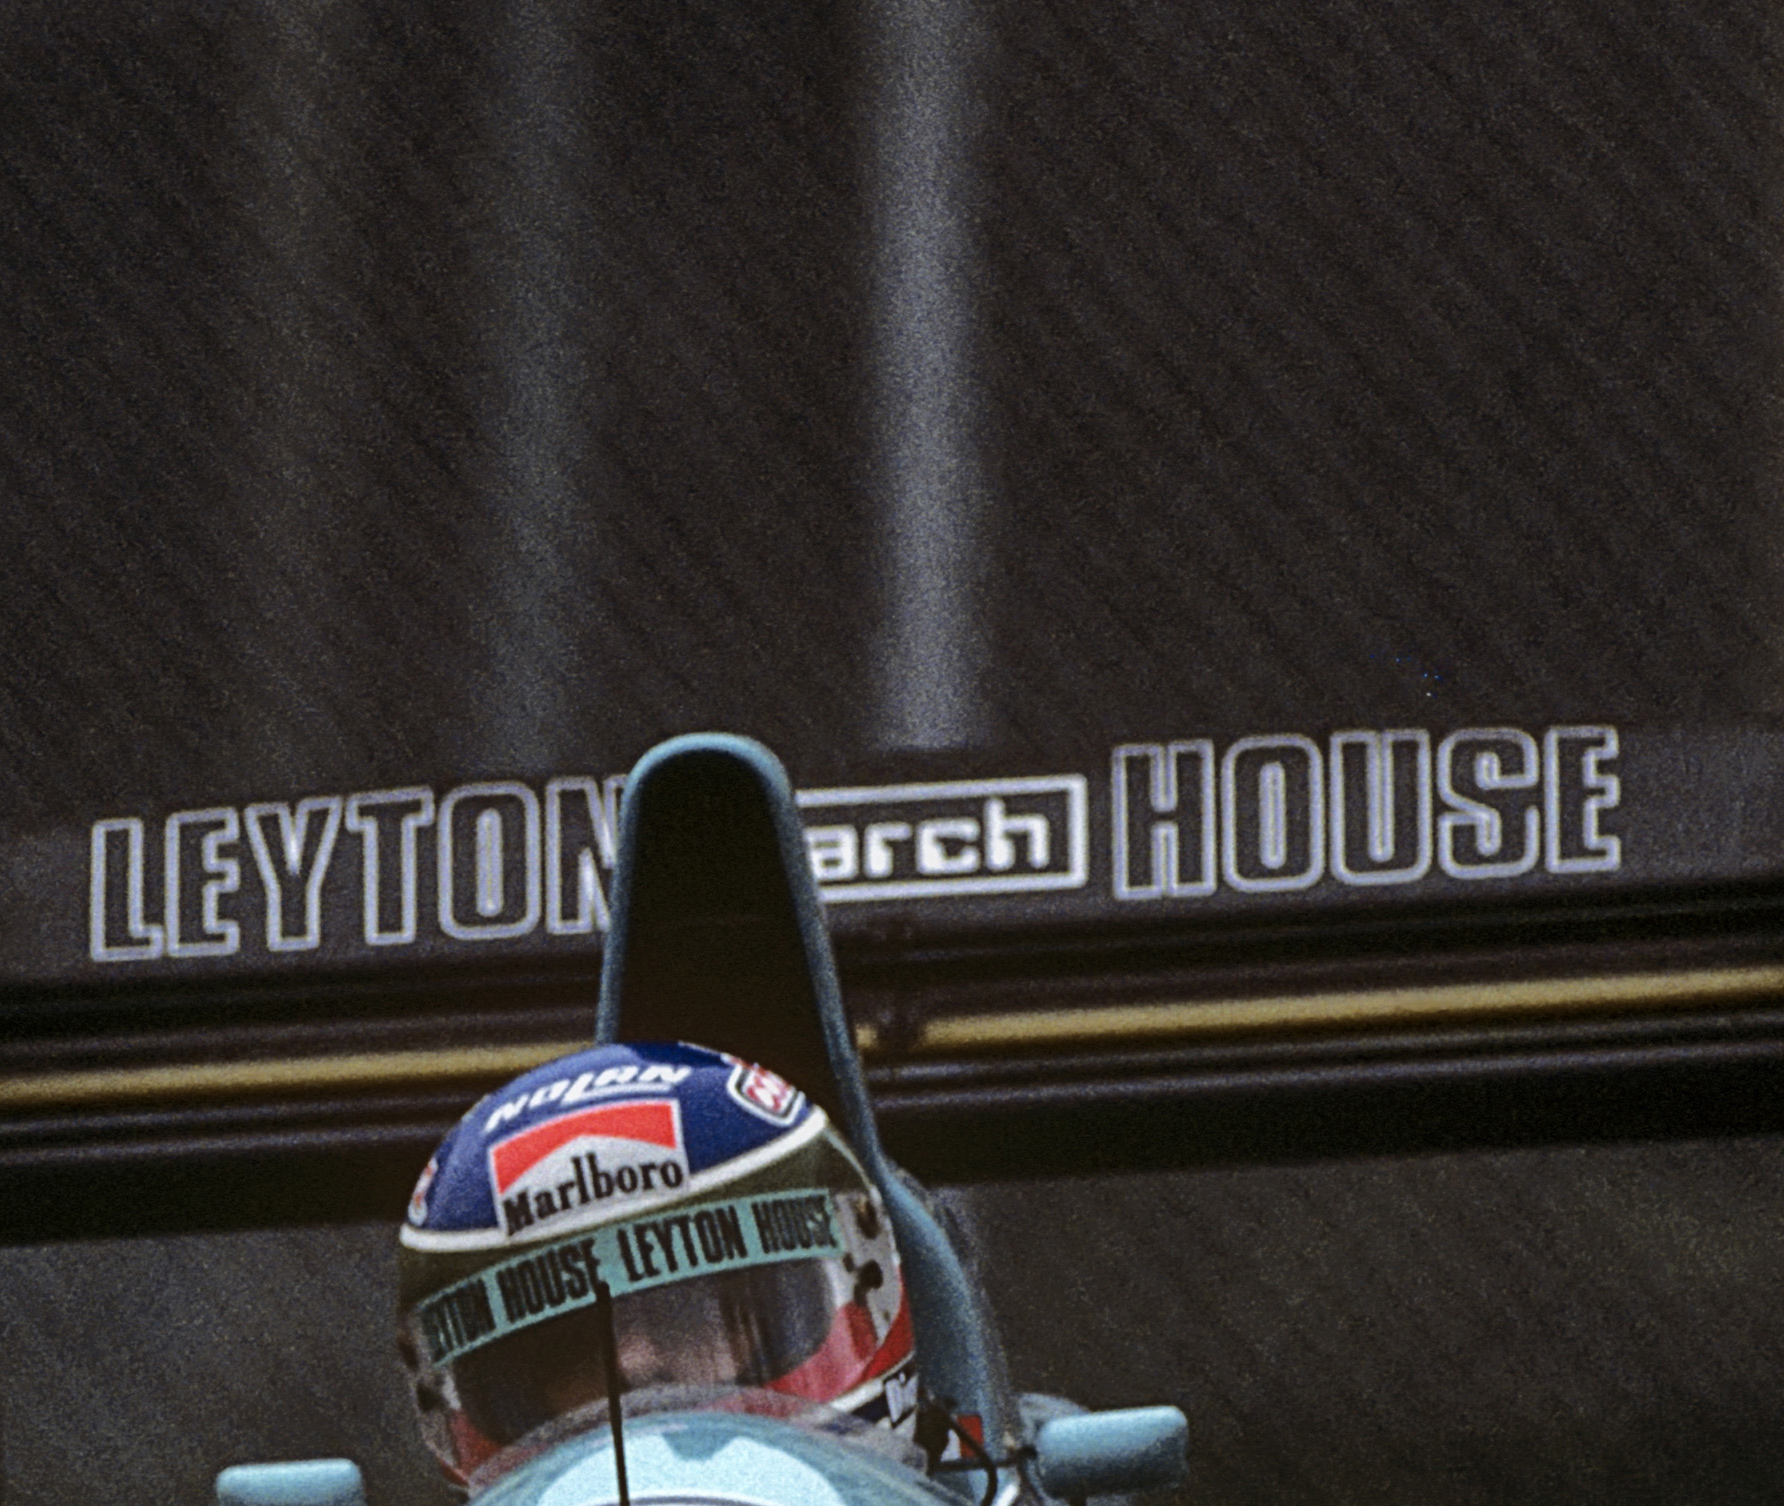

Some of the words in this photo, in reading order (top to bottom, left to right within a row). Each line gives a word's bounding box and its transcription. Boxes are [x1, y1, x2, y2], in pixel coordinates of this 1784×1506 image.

[805, 797, 1051, 879] arch
[1111, 726, 1621, 900] HOUSE
[90, 774, 627, 962] LEYTON
[482, 1064, 692, 1136] NOLAN
[503, 1151, 683, 1237] Marlboro
[617, 1204, 748, 1282] LEYTON
[751, 1195, 838, 1254] HOUSE
